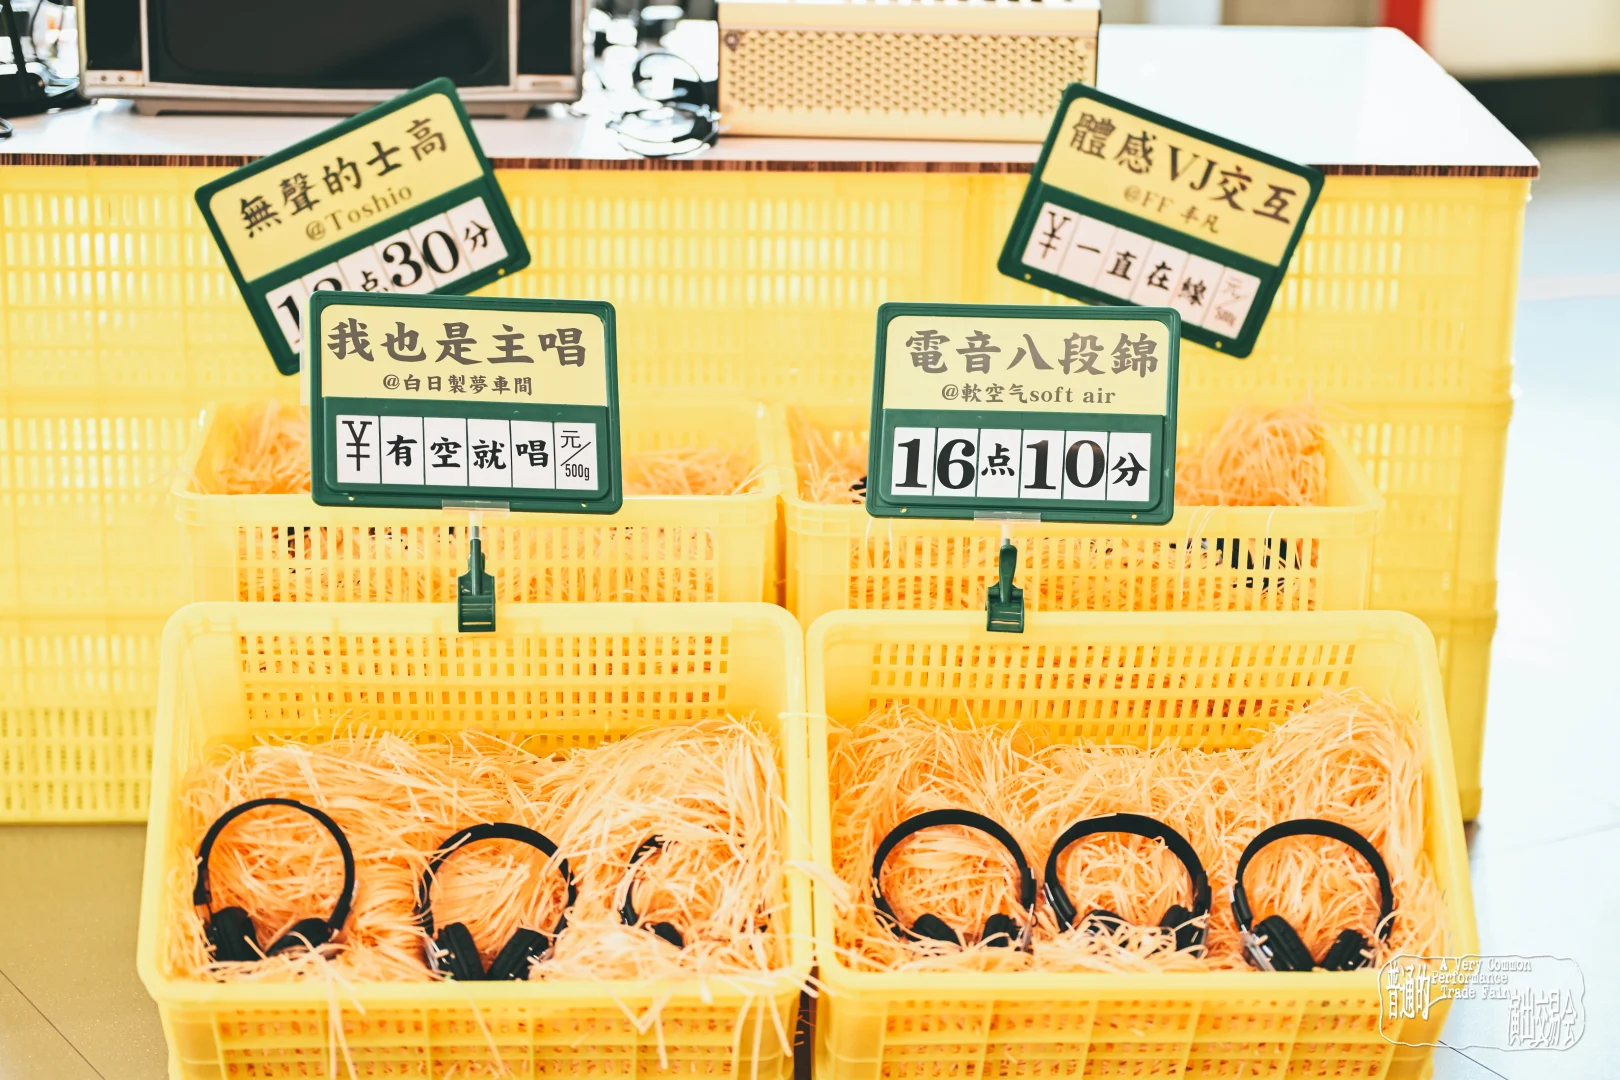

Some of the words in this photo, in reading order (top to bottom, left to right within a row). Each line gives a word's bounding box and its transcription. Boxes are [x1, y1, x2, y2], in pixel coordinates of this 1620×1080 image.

[239, 117, 449, 238] 無聲的士高
[1070, 111, 1298, 225] 體感VJ交互
[305, 184, 413, 241] @Toshio
[327, 317, 587, 368] 我也是主唱
[905, 329, 1159, 379] 電音八段錦
[382, 373, 533, 396] @白日製夢車間
[1082, 387, 1117, 404] air
[895, 438, 1148, 490] 16点10分
